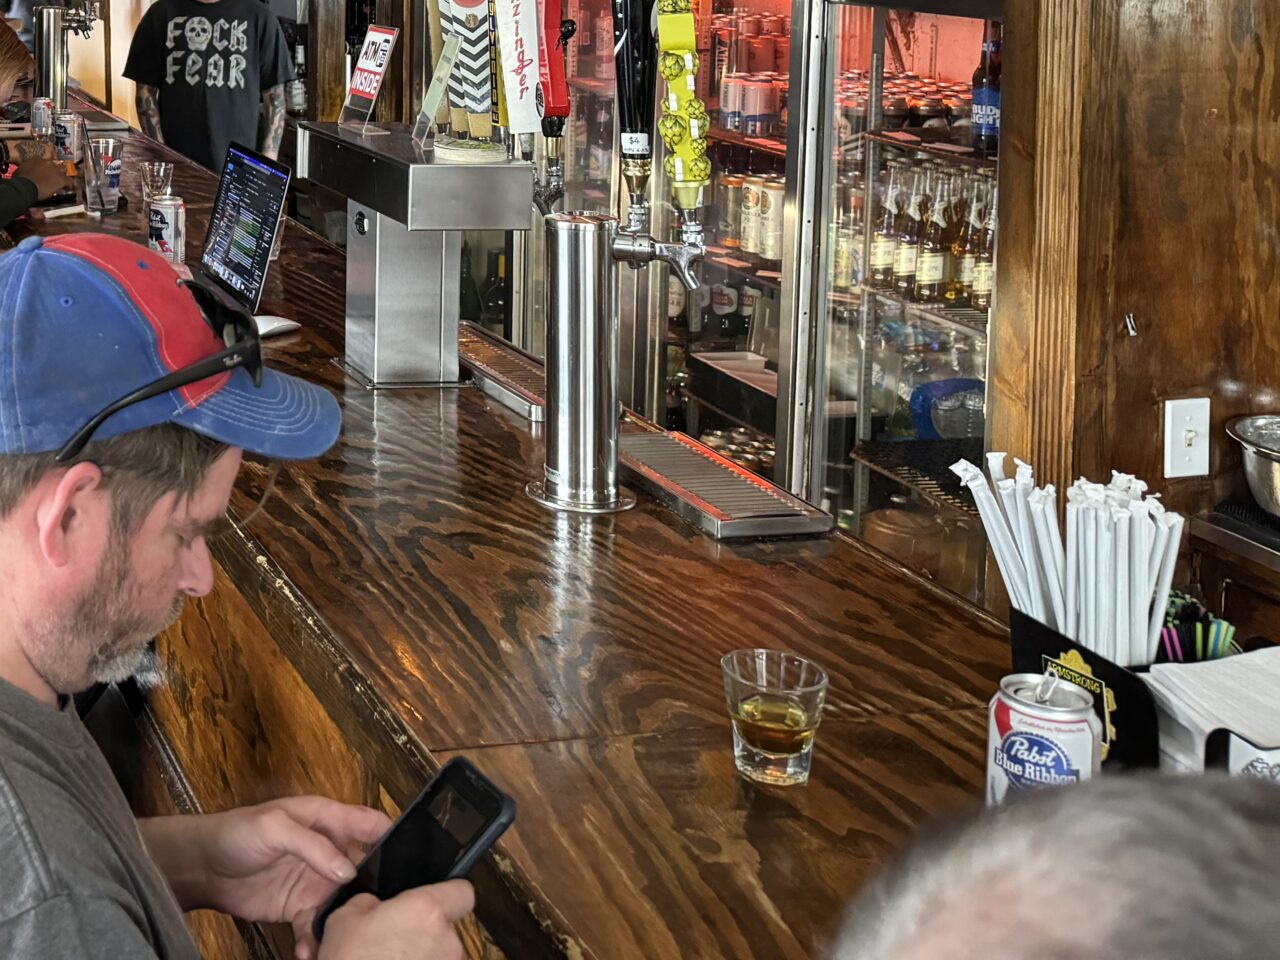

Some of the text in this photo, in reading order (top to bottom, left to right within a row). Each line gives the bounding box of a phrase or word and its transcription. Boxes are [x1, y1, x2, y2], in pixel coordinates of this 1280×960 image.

[362, 40, 381, 61] ATM
[351, 70, 380, 95] INSIDE
[1047, 661, 1101, 694] ARMSTRONG
[1010, 737, 1057, 766] Pabst
[996, 749, 1077, 784] Blue Ribbon
